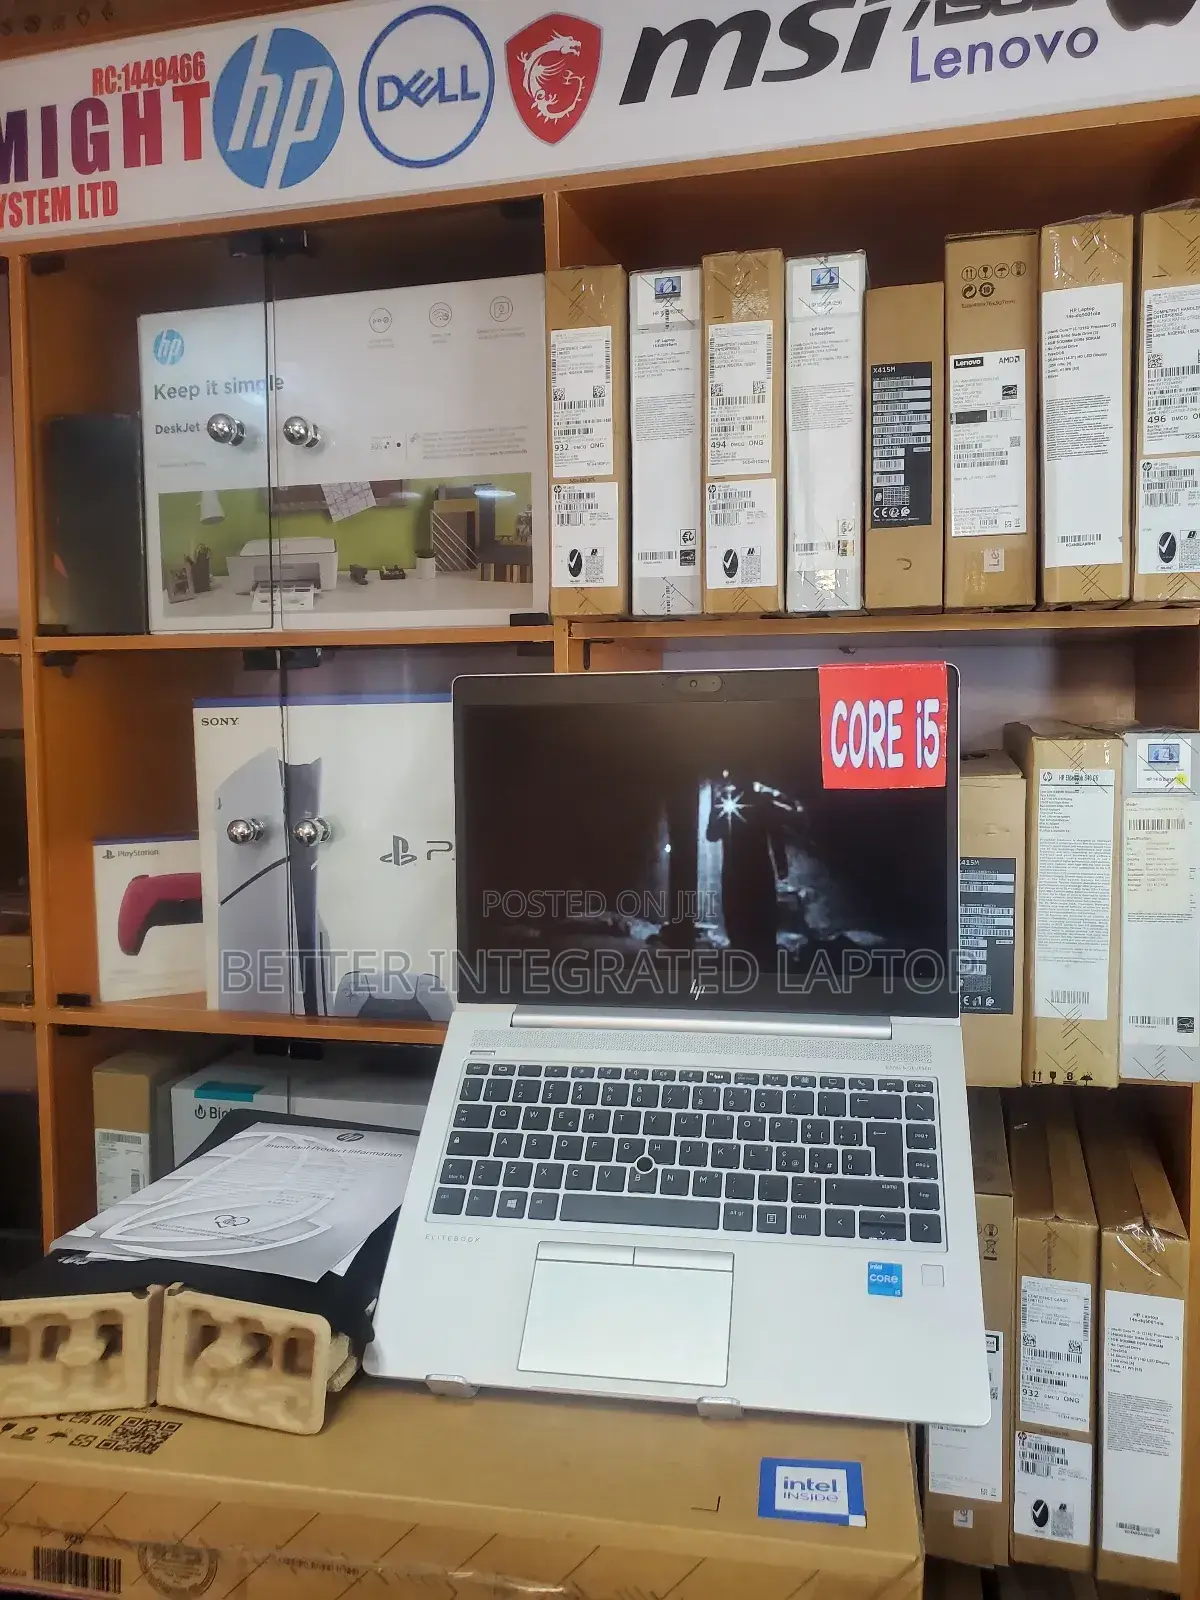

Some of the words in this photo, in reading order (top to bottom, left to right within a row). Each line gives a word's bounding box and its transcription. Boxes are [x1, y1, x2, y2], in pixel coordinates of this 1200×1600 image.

[619, 0, 892, 106] msi
[911, 26, 1099, 83] Lenovo
[92, 51, 206, 96] RC:1449466
[378, 64, 481, 112] DELL
[226, 28, 335, 189] hp
[78, 181, 119, 219] LTD
[153, 329, 185, 365] hp
[955, 358, 982, 367] Lenovo
[998, 356, 1015, 364] AMD
[873, 366, 896, 374] X415M
[154, 383, 200, 401] Keep
[206, 380, 219, 396] it
[224, 374, 285, 396] simple
[1148, 415, 1167, 424] 496
[155, 422, 200, 435] DeskJet
[554, 443, 569, 452] 932
[710, 441, 727, 449] 494
[201, 717, 240, 727] SONY
[830, 698, 904, 769] CORE
[916, 698, 941, 769] i5
[117, 849, 159, 859] PlayStation
[697, 1098, 703, 1106] 8
[499, 1109, 507, 1118] Q
[529, 1111, 539, 1119] W
[558, 1111, 565, 1119] E
[775, 1121, 781, 1129] P
[500, 1138, 508, 1146] A
[531, 1138, 537, 1146] S
[591, 1141, 598, 1149] F
[623, 1142, 631, 1150] G
[265, 1143, 309, 1151] Important
[311, 1145, 347, 1153] Product
[349, 1149, 403, 1159] Information
[510, 1166, 517, 1174] Z
[540, 1168, 548, 1176] X
[572, 1169, 579, 1177] C
[604, 1170, 611, 1178] V
[634, 1174, 641, 1182] B
[667, 1174, 674, 1182] N
[425, 1234, 481, 1243] ELITEBOOK
[1022, 1388, 1039, 1399] 932
[1063, 1396, 1080, 1404] ONG
[783, 1476, 838, 1493] intel
